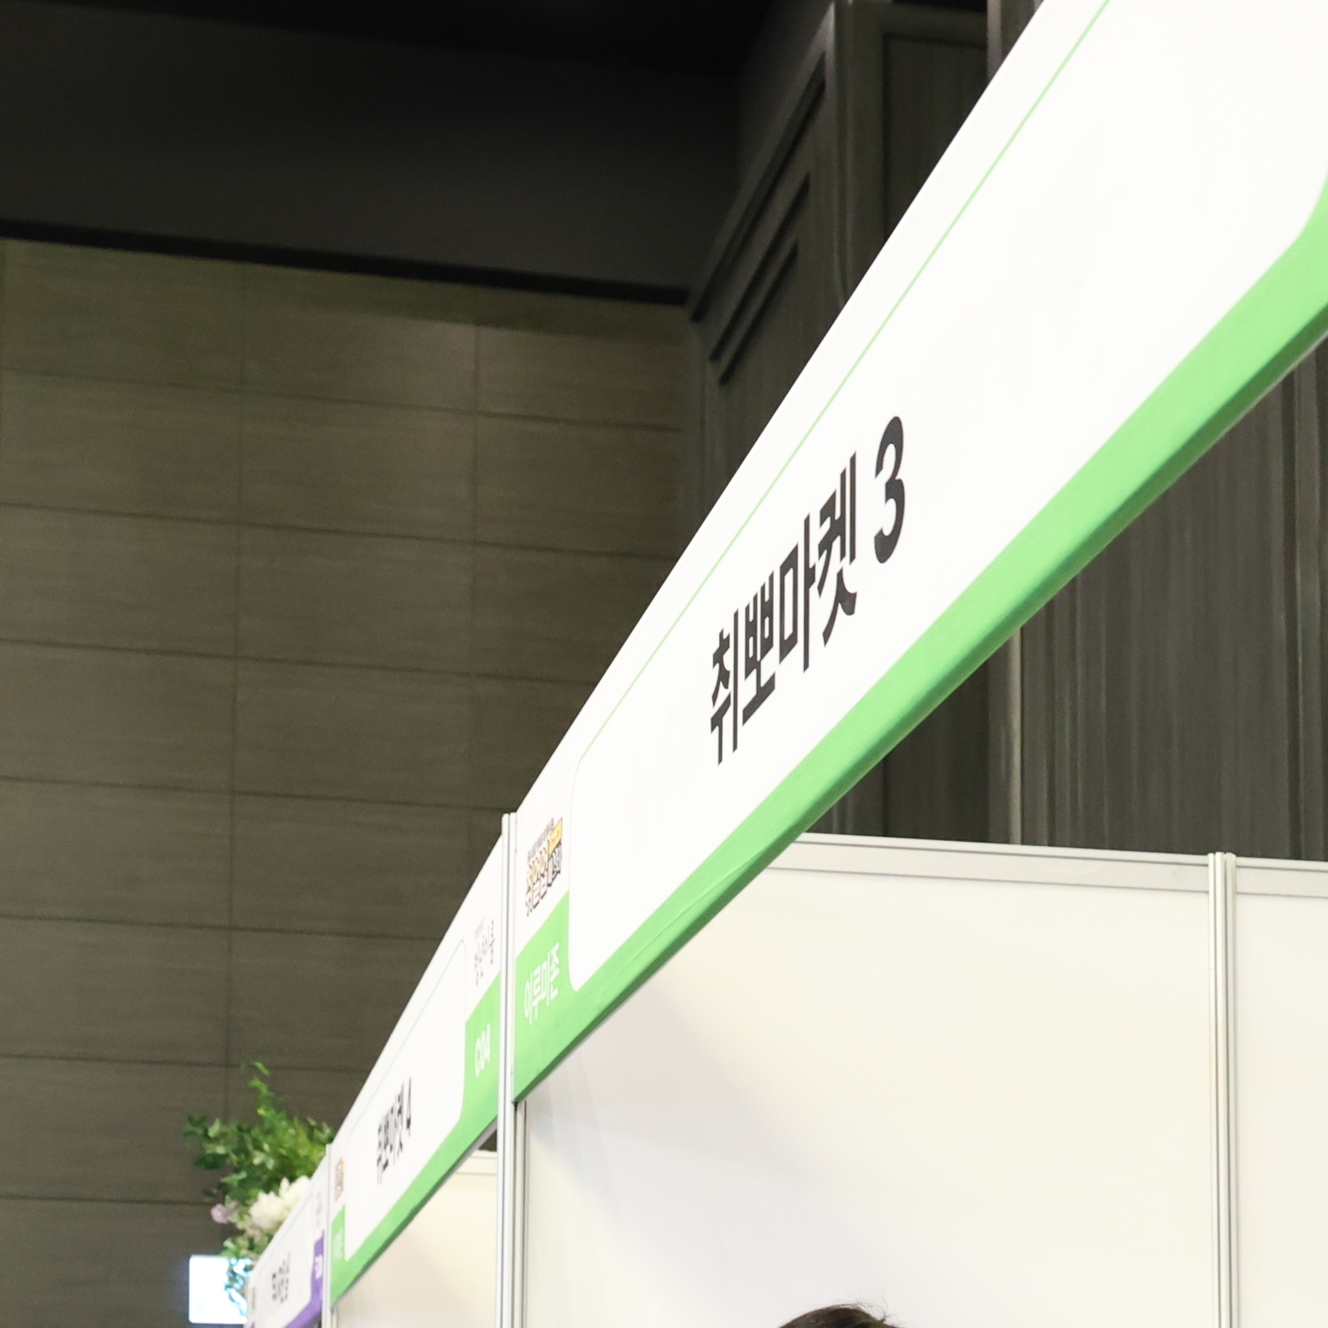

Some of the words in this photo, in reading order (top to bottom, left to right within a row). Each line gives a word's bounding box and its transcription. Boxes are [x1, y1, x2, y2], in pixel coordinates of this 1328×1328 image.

[710, 450, 858, 766] 취뽀마켓
[873, 415, 907, 564] 3
[524, 942, 561, 1026] 이루미존
[474, 1022, 491, 1078] C04
